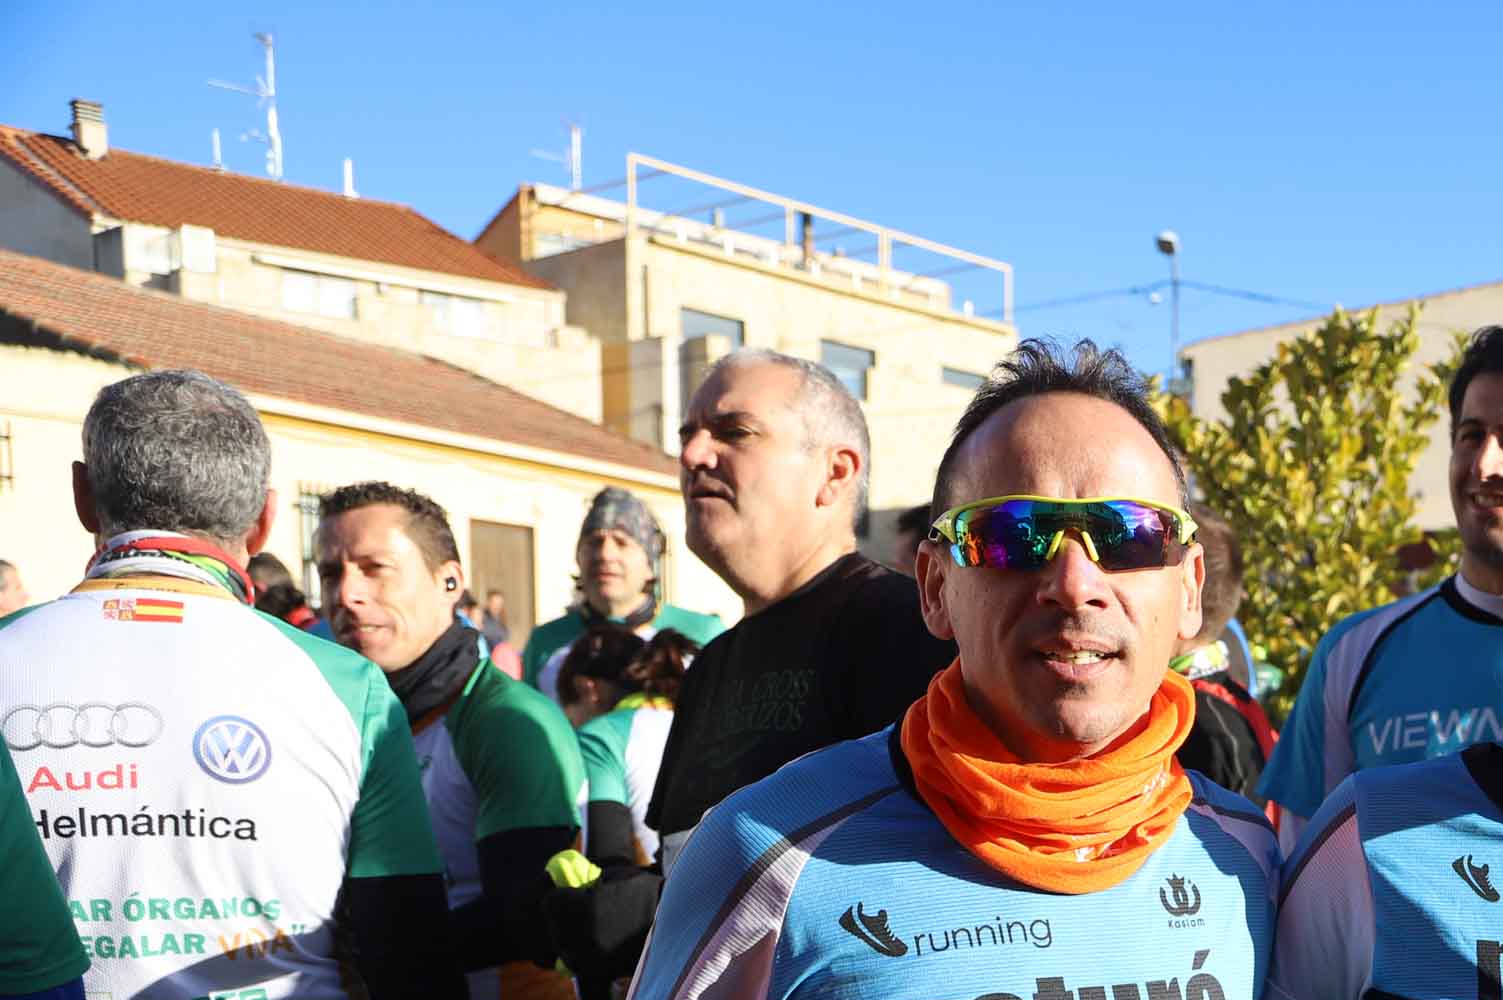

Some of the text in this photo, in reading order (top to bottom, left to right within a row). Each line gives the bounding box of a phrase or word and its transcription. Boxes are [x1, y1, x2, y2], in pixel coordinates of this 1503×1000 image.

[27, 763, 138, 794] Audi
[123, 892, 281, 922] ÓRGANOS
[914, 915, 1053, 957] running
